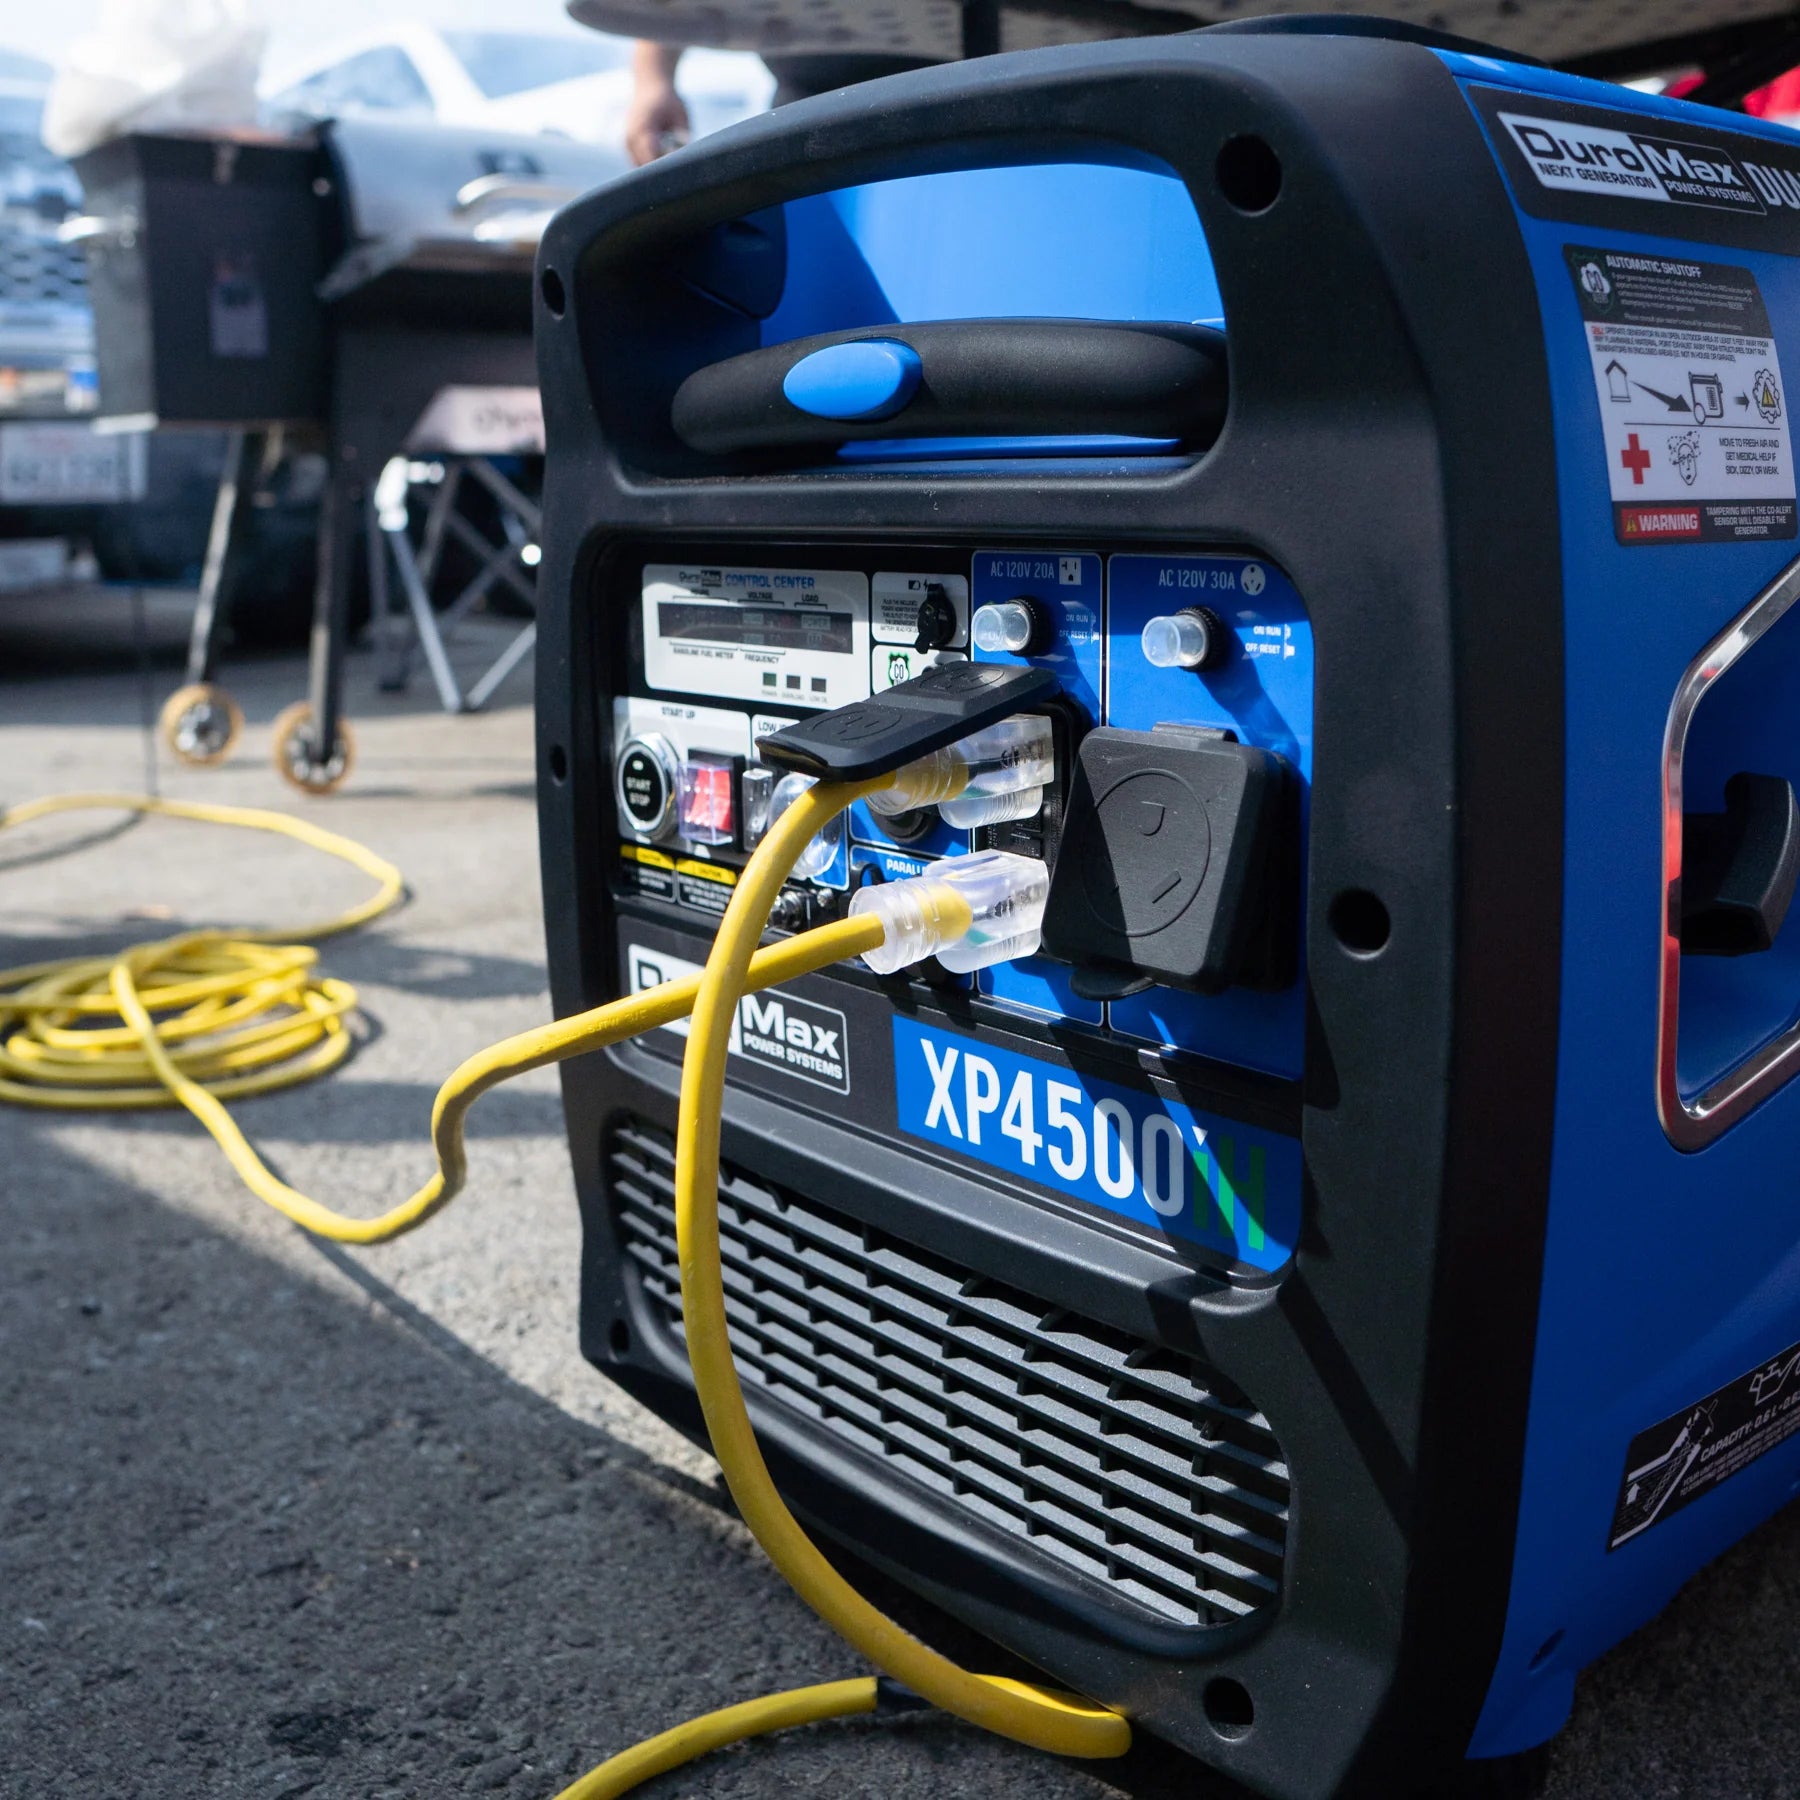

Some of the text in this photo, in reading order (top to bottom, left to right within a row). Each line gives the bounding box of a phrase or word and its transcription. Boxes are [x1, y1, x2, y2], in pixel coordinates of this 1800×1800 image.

[1537, 162, 1657, 190] NEXT GENERATION
[1666, 180, 1756, 203] POWER SYSTEMS
[1606, 255, 1702, 278] AUTOMATIC SHUTOFF
[1719, 438, 1735, 447] MOVE
[1735, 438, 1742, 447] TO
[1743, 438, 1758, 448] FRESH
[1769, 439, 1779, 448] AND
[1726, 451, 1735, 460] GET
[1736, 452, 1759, 461] MEDICAL
[1759, 452, 1771, 461] HELP
[1755, 466, 1762, 474] OR
[1706, 506, 1739, 516] TAMPERING
[1740, 506, 1755, 515] WITH
[1756, 506, 1766, 515] THE
[1638, 513, 1698, 531] WARNING
[1714, 515, 1786, 526] SENSOR WILL DISABLE THE
[990, 560, 1055, 579] AC 120V 20A
[725, 573, 815, 590] CONTROL CENTER
[1158, 568, 1236, 590] AC 120V 30A
[801, 594, 819, 603] LOAD
[1066, 614, 1088, 623] ON RUN
[1070, 630, 1088, 639] RESET
[1253, 625, 1281, 636] ON RUN
[1245, 642, 1280, 654] OFF RESET
[745, 654, 780, 664] FREQUENCY
[894, 663, 904, 679] CO
[661, 706, 684, 717] START
[758, 721, 776, 732] LOW
[626, 776, 652, 792] START
[629, 792, 651, 807] STOP
[743, 1031, 786, 1060] POWER
[786, 1046, 844, 1080] SYSTEMS
